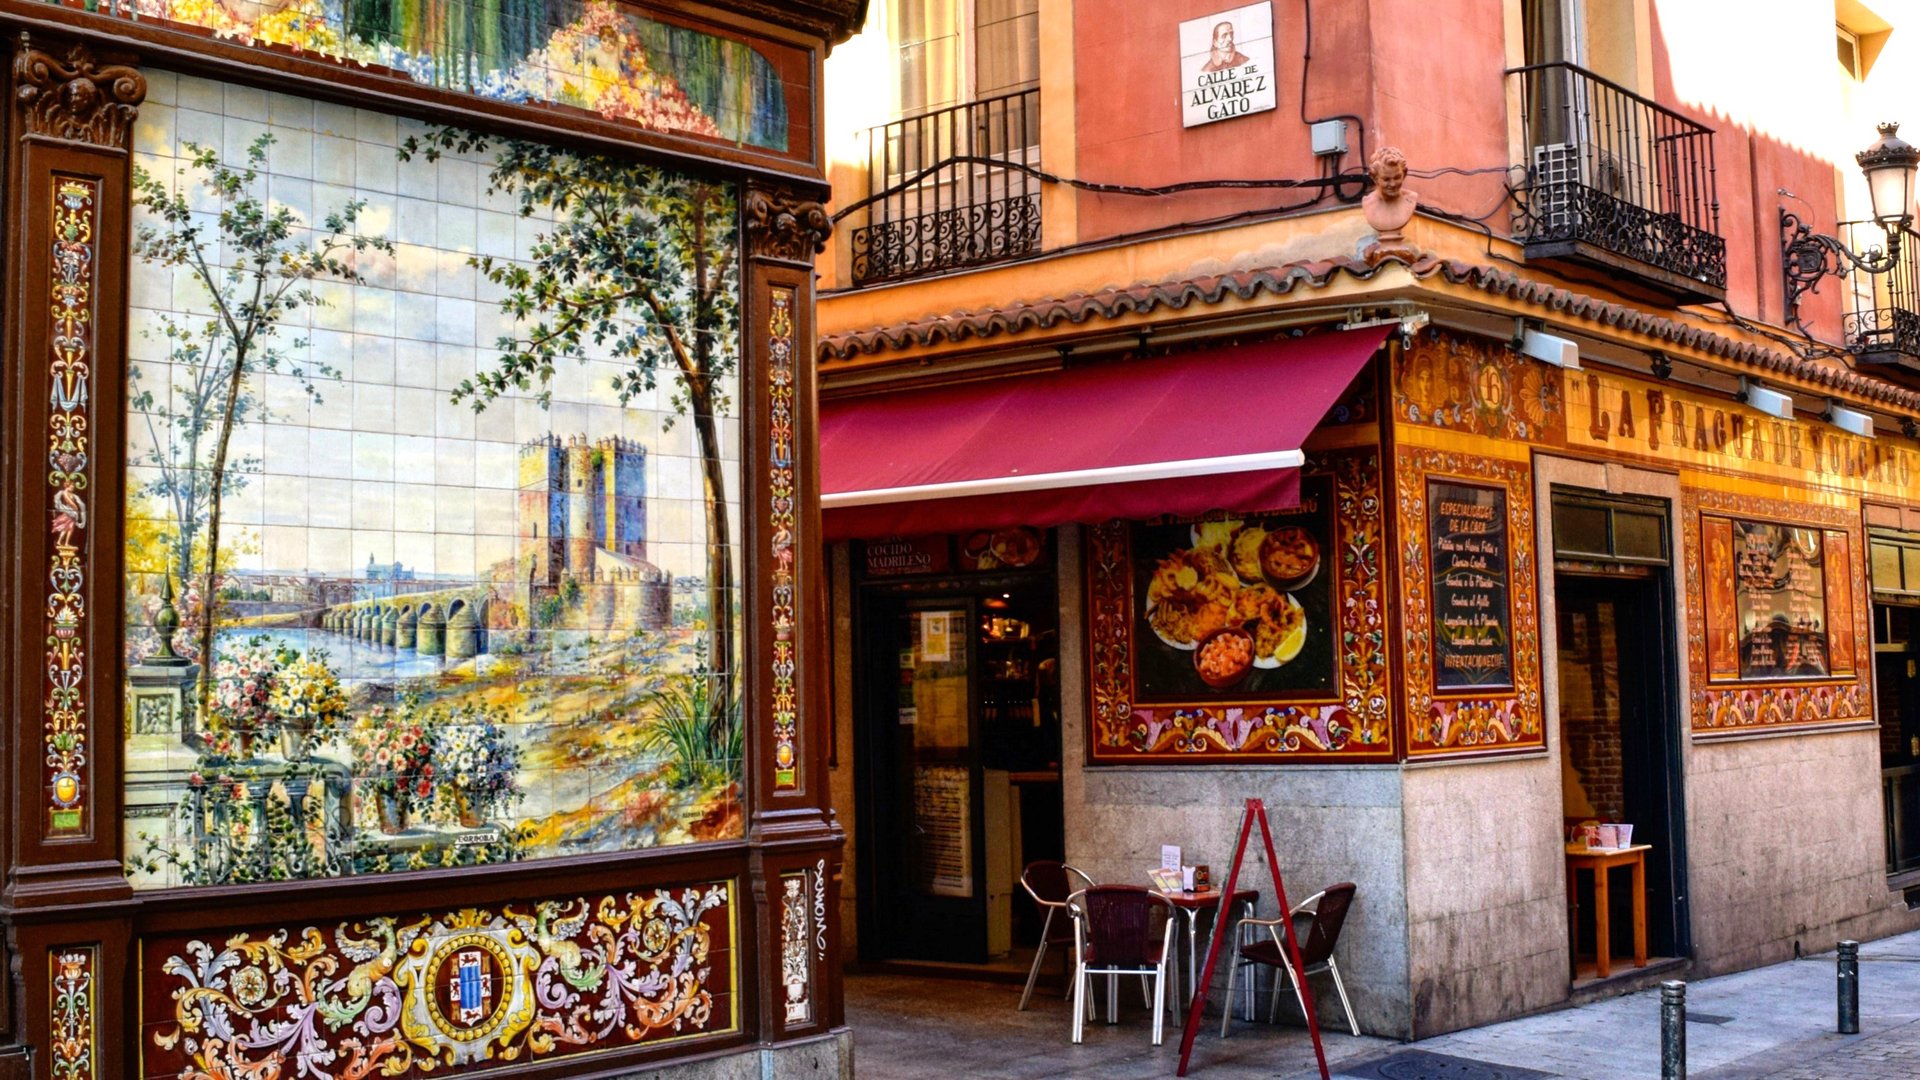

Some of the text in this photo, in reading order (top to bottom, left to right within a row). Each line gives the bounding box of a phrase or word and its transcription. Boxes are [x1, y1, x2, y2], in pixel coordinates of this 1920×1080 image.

[1198, 64, 1258, 87] CALLE DE
[1191, 75, 1267, 107] ALVAREZ
[1207, 98, 1250, 120] GATO
[1484, 367, 1501, 405] 16
[1646, 388, 1764, 461] FRAGUA
[1772, 422, 1801, 468] DE
[867, 543, 912, 557] COCIDO
[867, 552, 931, 568] MADRILEÑO
